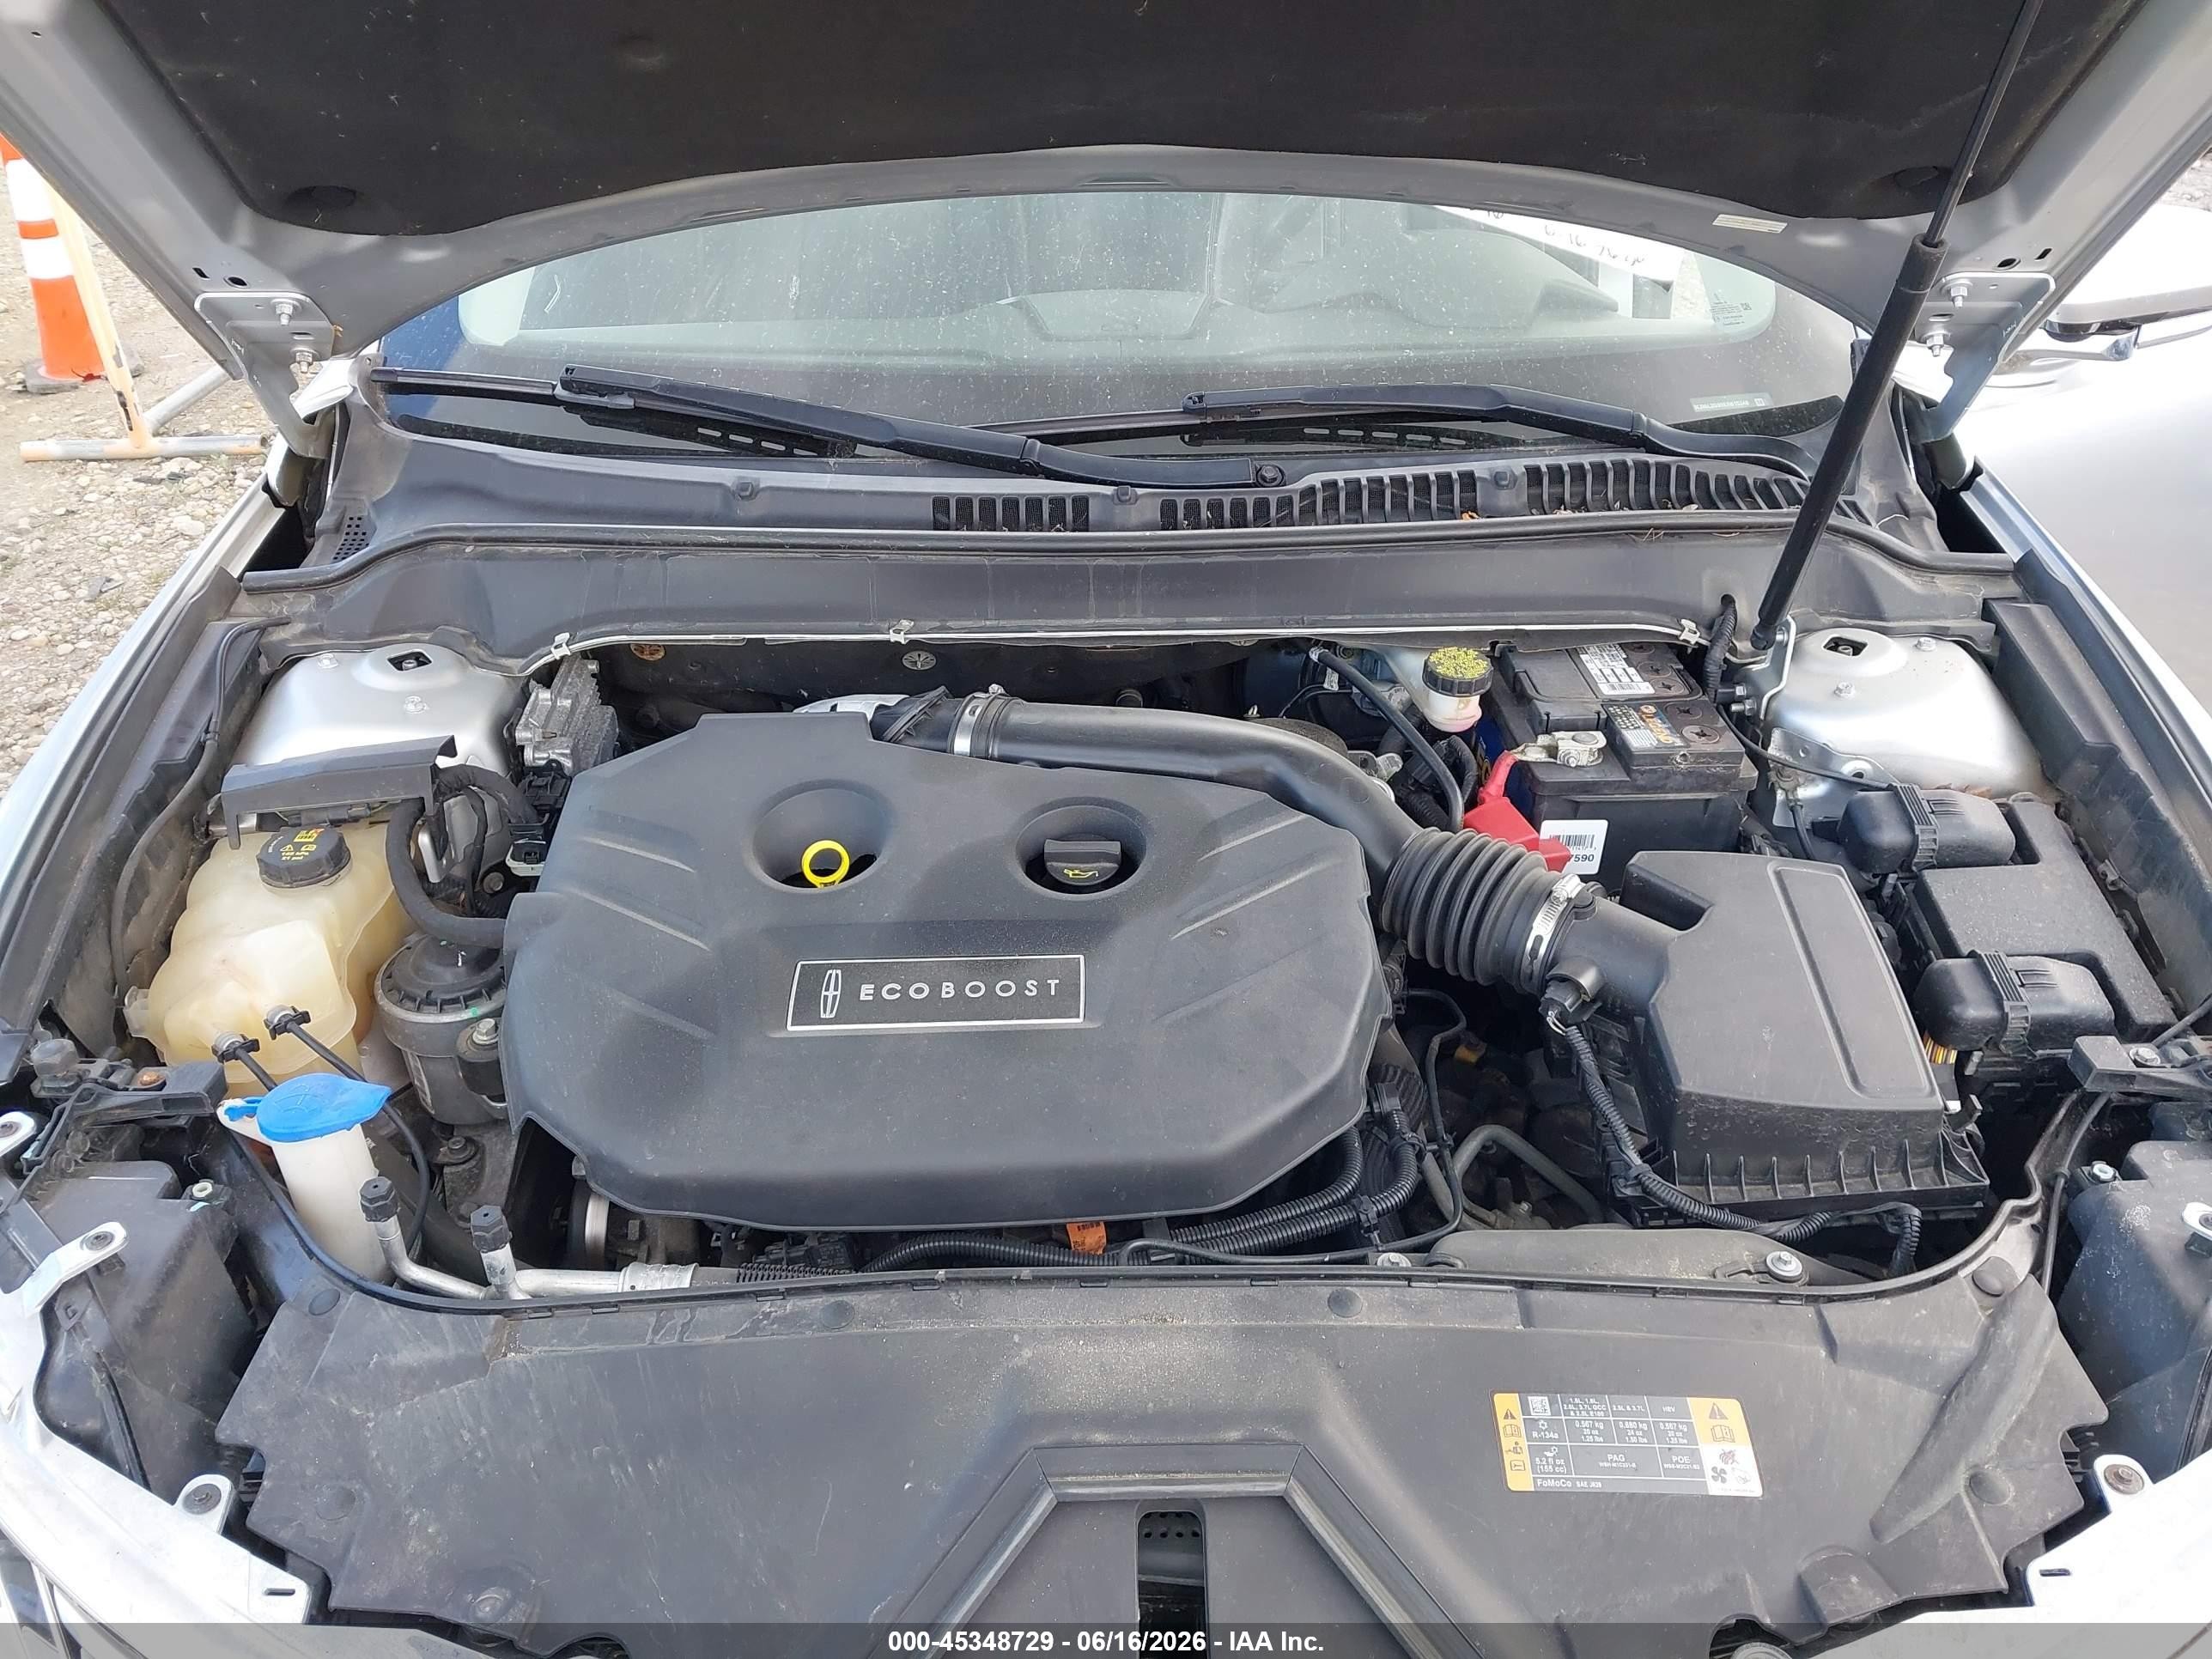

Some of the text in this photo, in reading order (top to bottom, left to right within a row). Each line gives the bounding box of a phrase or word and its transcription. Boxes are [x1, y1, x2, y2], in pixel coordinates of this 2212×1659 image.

[1571, 854, 1594, 862] 590
[860, 979, 1060, 1000] ECOBOOST
[1594, 1420, 1604, 1429] kg
[1639, 1422, 1648, 1431] kg
[1678, 1423, 1688, 1432] kg
[1672, 1455, 1690, 1464] POE
[1537, 1465, 1567, 1474] (155 cc)
[1537, 1478, 1572, 1488] FoMoCo
